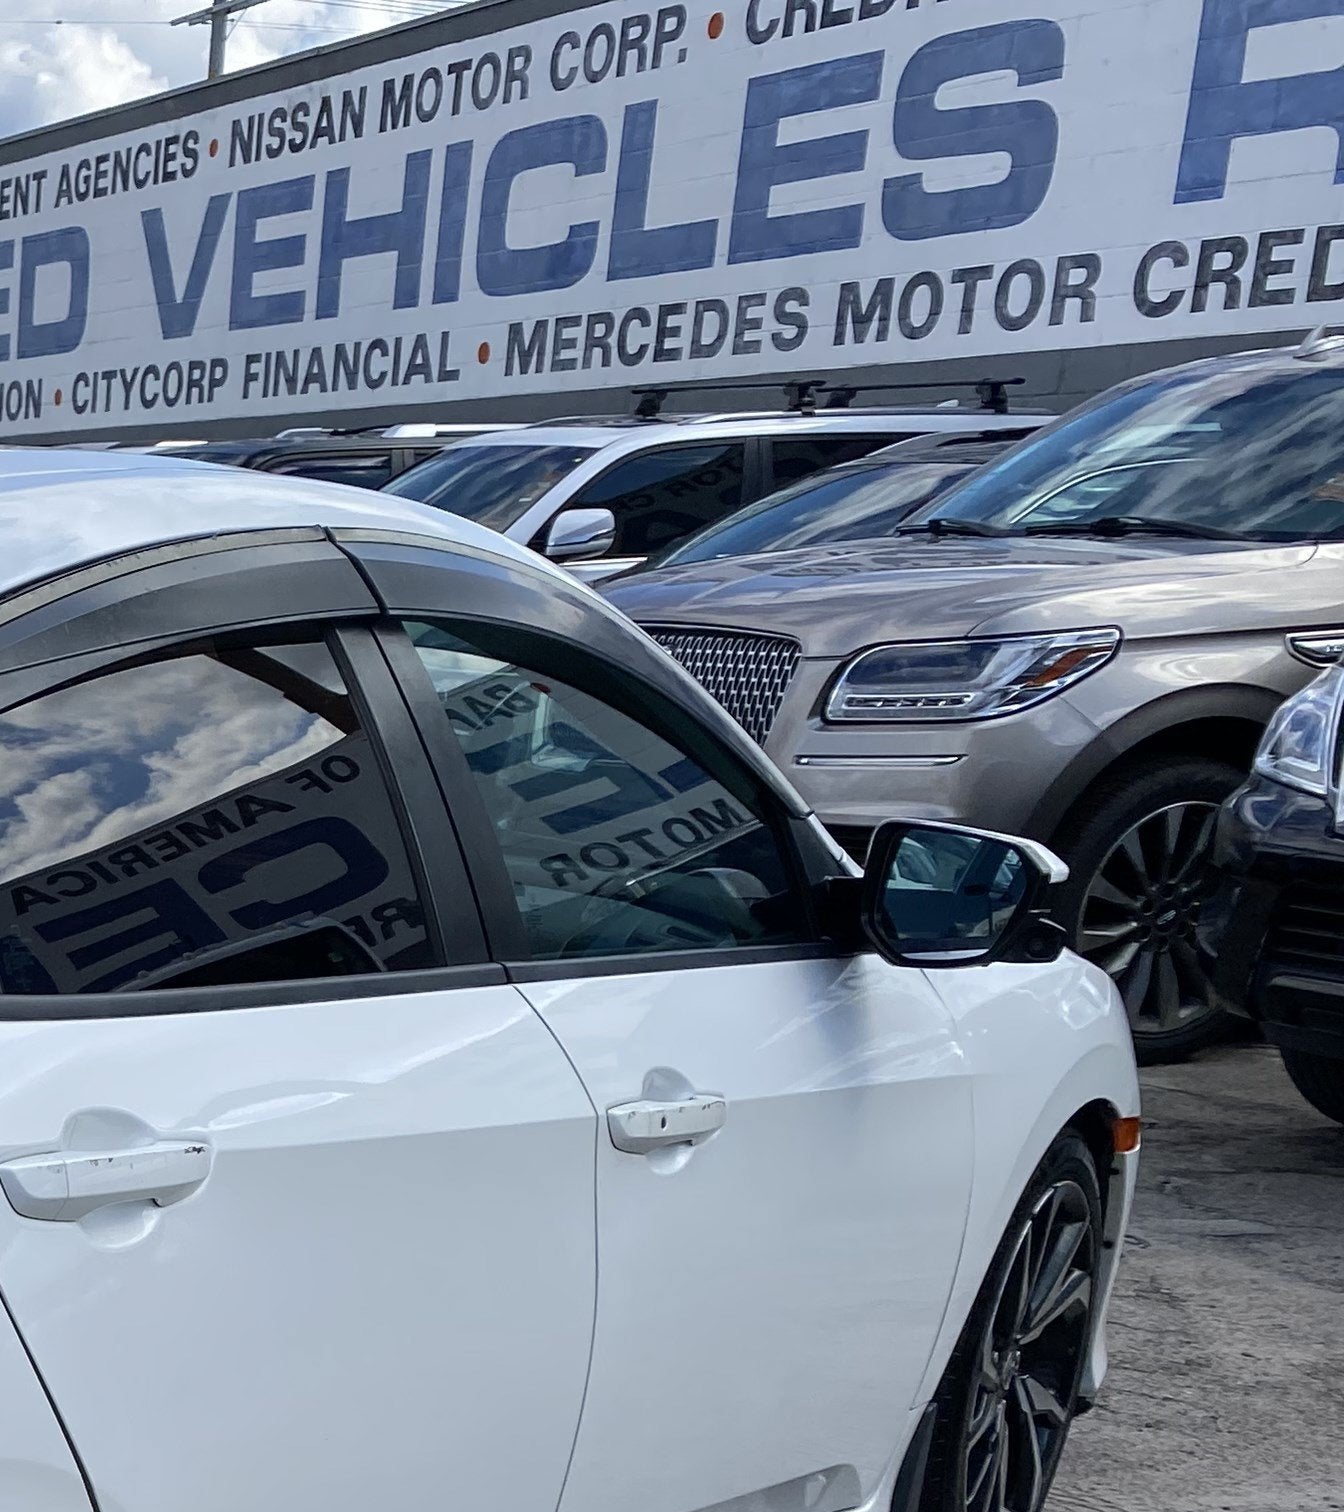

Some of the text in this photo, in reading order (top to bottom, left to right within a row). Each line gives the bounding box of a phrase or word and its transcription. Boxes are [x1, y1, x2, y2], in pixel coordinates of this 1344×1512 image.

[54, 130, 200, 209] AGENCIES
[229, 85, 368, 168] NISSAN
[379, 44, 532, 134] MOTOR
[550, 3, 687, 92] CORP.
[142, 18, 1067, 339] VEHICLES
[71, 357, 228, 415] CITYCORP
[242, 331, 461, 400] FINANCIAL
[504, 285, 810, 377] MERCEDES
[833, 251, 1102, 346] MOTOR
